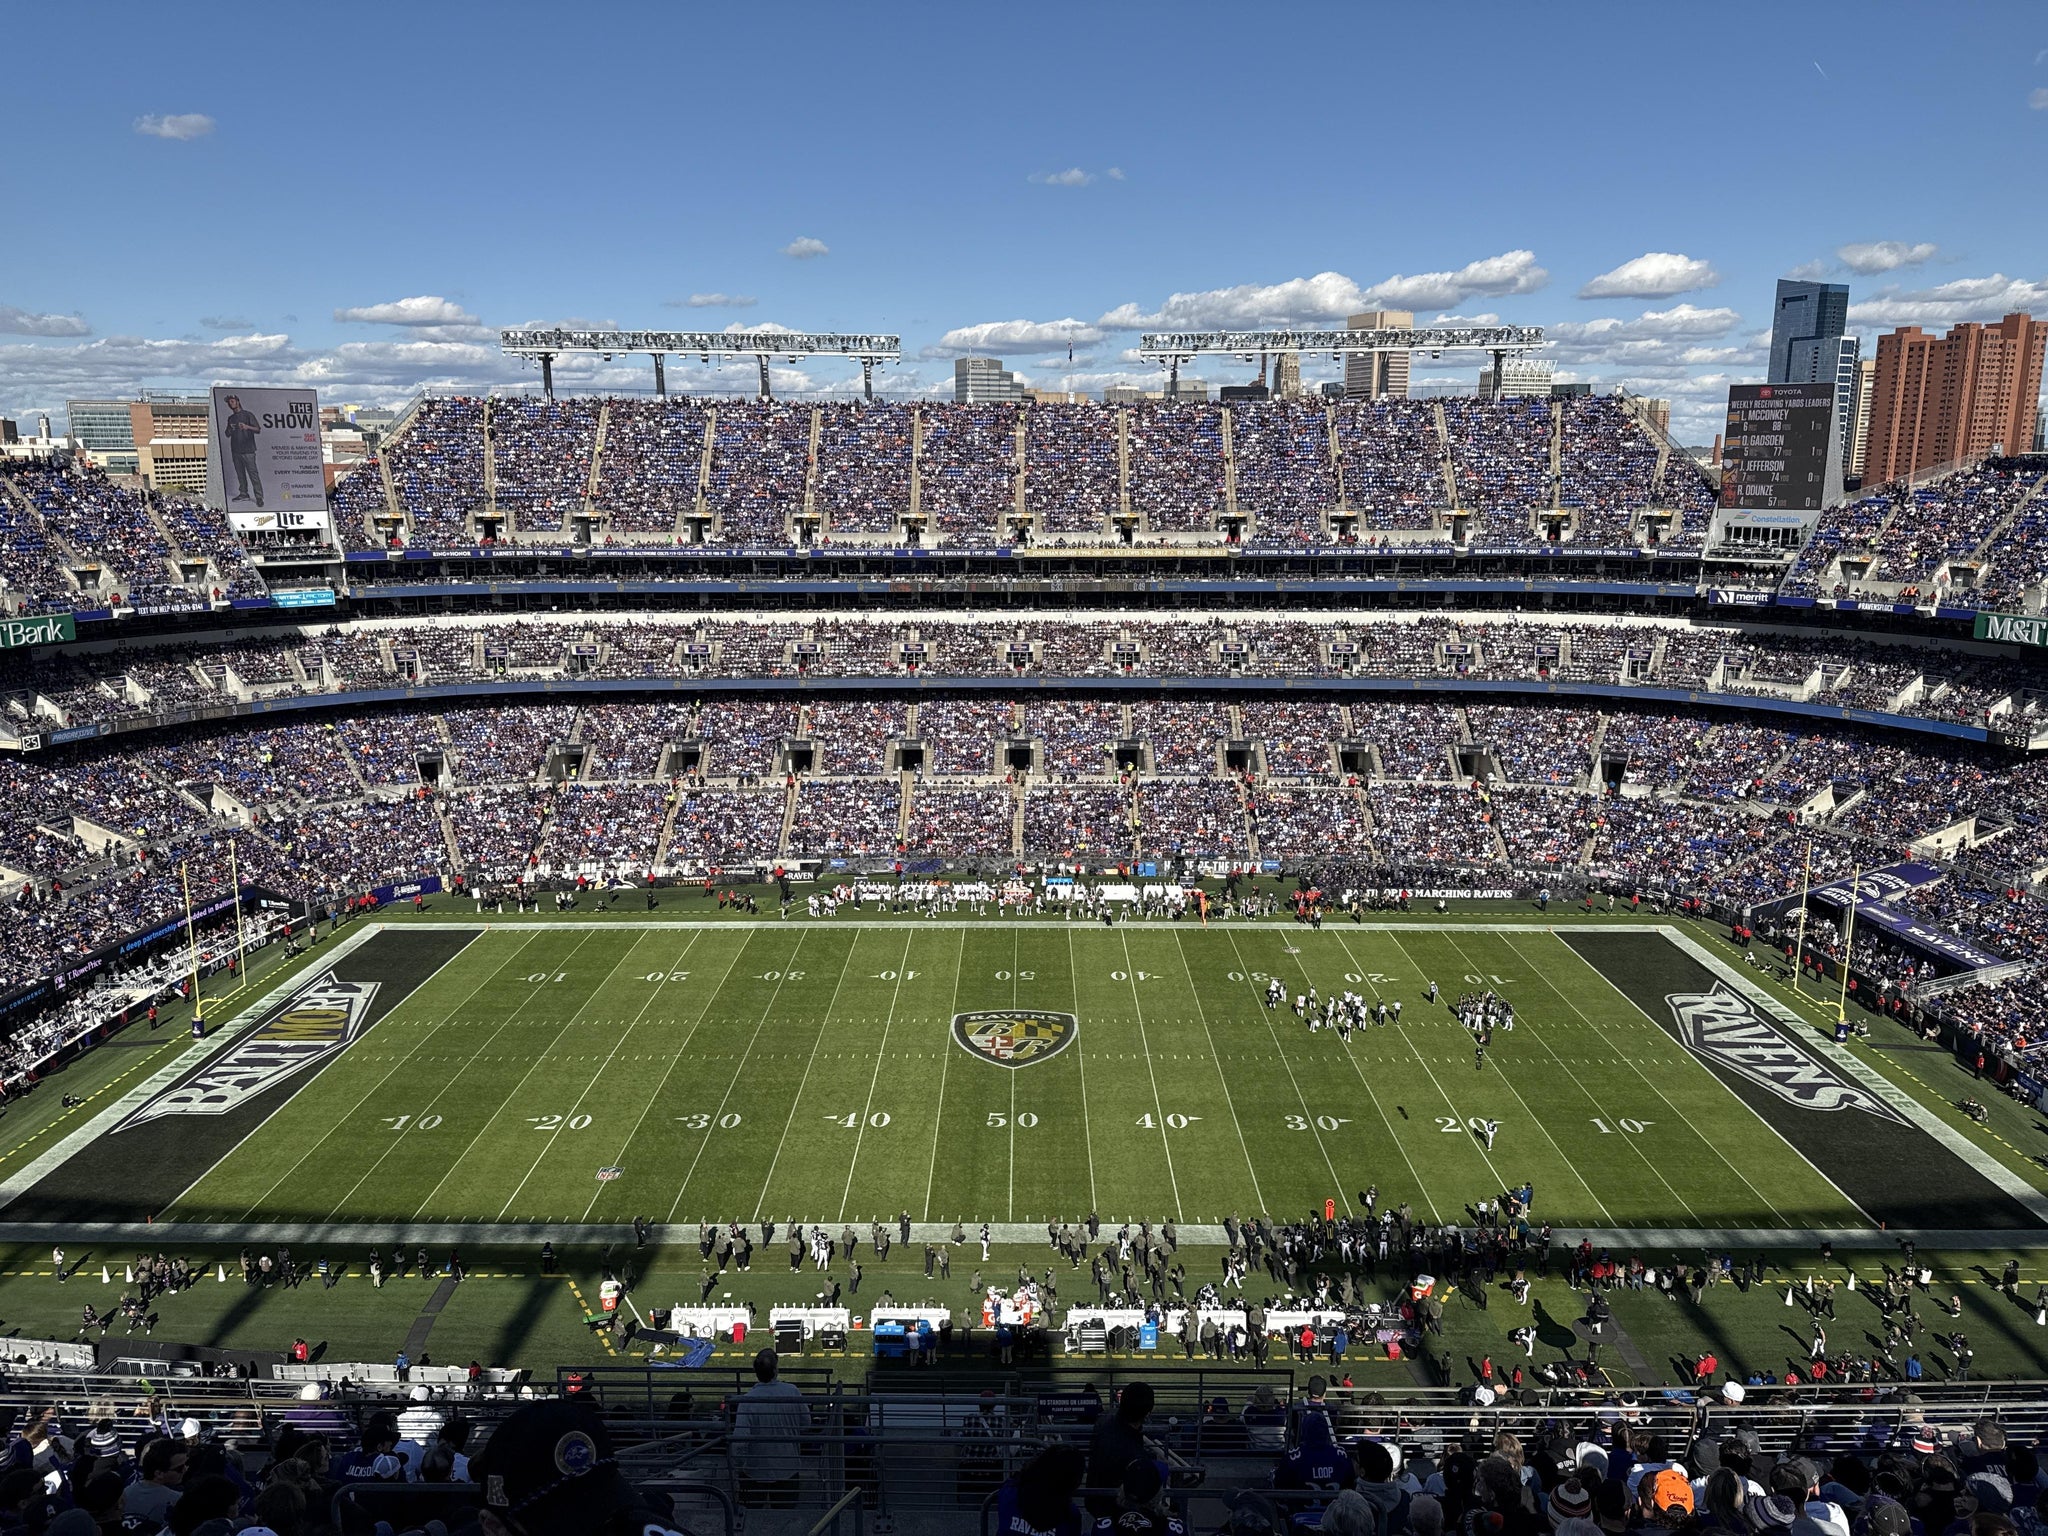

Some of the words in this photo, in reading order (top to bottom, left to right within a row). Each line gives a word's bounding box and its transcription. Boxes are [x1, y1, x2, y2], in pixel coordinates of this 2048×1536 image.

[291, 403, 311, 413] THE
[1731, 400, 1753, 409] WEEKLY
[1754, 399, 1783, 409] RECEIVING
[1784, 398, 1804, 408] YARDS
[1805, 398, 1831, 407] LEADERS
[1741, 410, 1747, 421] L.
[1748, 409, 1789, 421] MCCONKEY
[263, 414, 313, 429] SHOW
[1743, 421, 1748, 431] 6
[1750, 435, 1785, 446] GADSDEN
[1743, 447, 1749, 456] 5
[1773, 447, 1782, 456] 77
[1746, 460, 1784, 472] JEFFERSON
[1742, 473, 1747, 482] 7
[1771, 472, 1780, 482] 74
[1808, 472, 1813, 482] 0
[1737, 485, 1744, 495] R.
[1745, 484, 1773, 495] ODUNZE
[1739, 497, 1744, 506] 4
[1768, 497, 1777, 507] 57
[1805, 497, 1811, 507] 0
[276, 512, 304, 529] Lite
[1736, 592, 1768, 602] merritt
[138, 607, 149, 615] TEXT
[150, 606, 158, 614] FOR
[8, 618, 64, 646] Bank
[1985, 616, 2046, 645] M&T
[52, 728, 95, 741] PROGRESSIVE
[24, 737, 37, 749] 25
[2004, 736, 2026, 748] 6:33
[1212, 861, 1230, 872] THE
[788, 872, 814, 880] RAVEN
[1415, 889, 1472, 898] MARCHING
[1473, 890, 1513, 898] RAVENS
[120, 946, 125, 954] A
[126, 938, 142, 952] deep
[142, 922, 177, 946] partnership
[208, 906, 214, 914] in
[214, 896, 243, 910] Baltimoe
[1906, 925, 1992, 966] RAVENS
[211, 937, 266, 972] MARYAND
[643, 972, 691, 982] 20
[764, 970, 806, 982] 30
[880, 970, 922, 981] 40
[994, 970, 1036, 981] 50
[1110, 970, 1152, 982] 40
[1344, 972, 1388, 984] 20
[9, 987, 46, 1010] CONFIDENCE
[968, 1014, 1060, 1022] RAVENS
[112, 972, 379, 1132] BALTIMORE
[1667, 981, 1909, 1125] RAVENS
[1747, 988, 1808, 1033] SALUTE
[1831, 1051, 1914, 1112] SERVICE
[150, 1040, 212, 1091] TAKES
[386, 1114, 443, 1130] 10
[534, 1114, 592, 1130] 20
[686, 1113, 742, 1129] 30
[837, 1112, 891, 1128] 40
[986, 1112, 1039, 1128] 50
[1135, 1113, 1188, 1129] 40
[1284, 1114, 1337, 1131] 30
[1434, 1116, 1486, 1132] 20
[1589, 1117, 1641, 1134] 10
[345, 1464, 374, 1478] JACKSO
[1312, 1466, 1334, 1479] LOOP
[1666, 1492, 1688, 1504] Chicago
